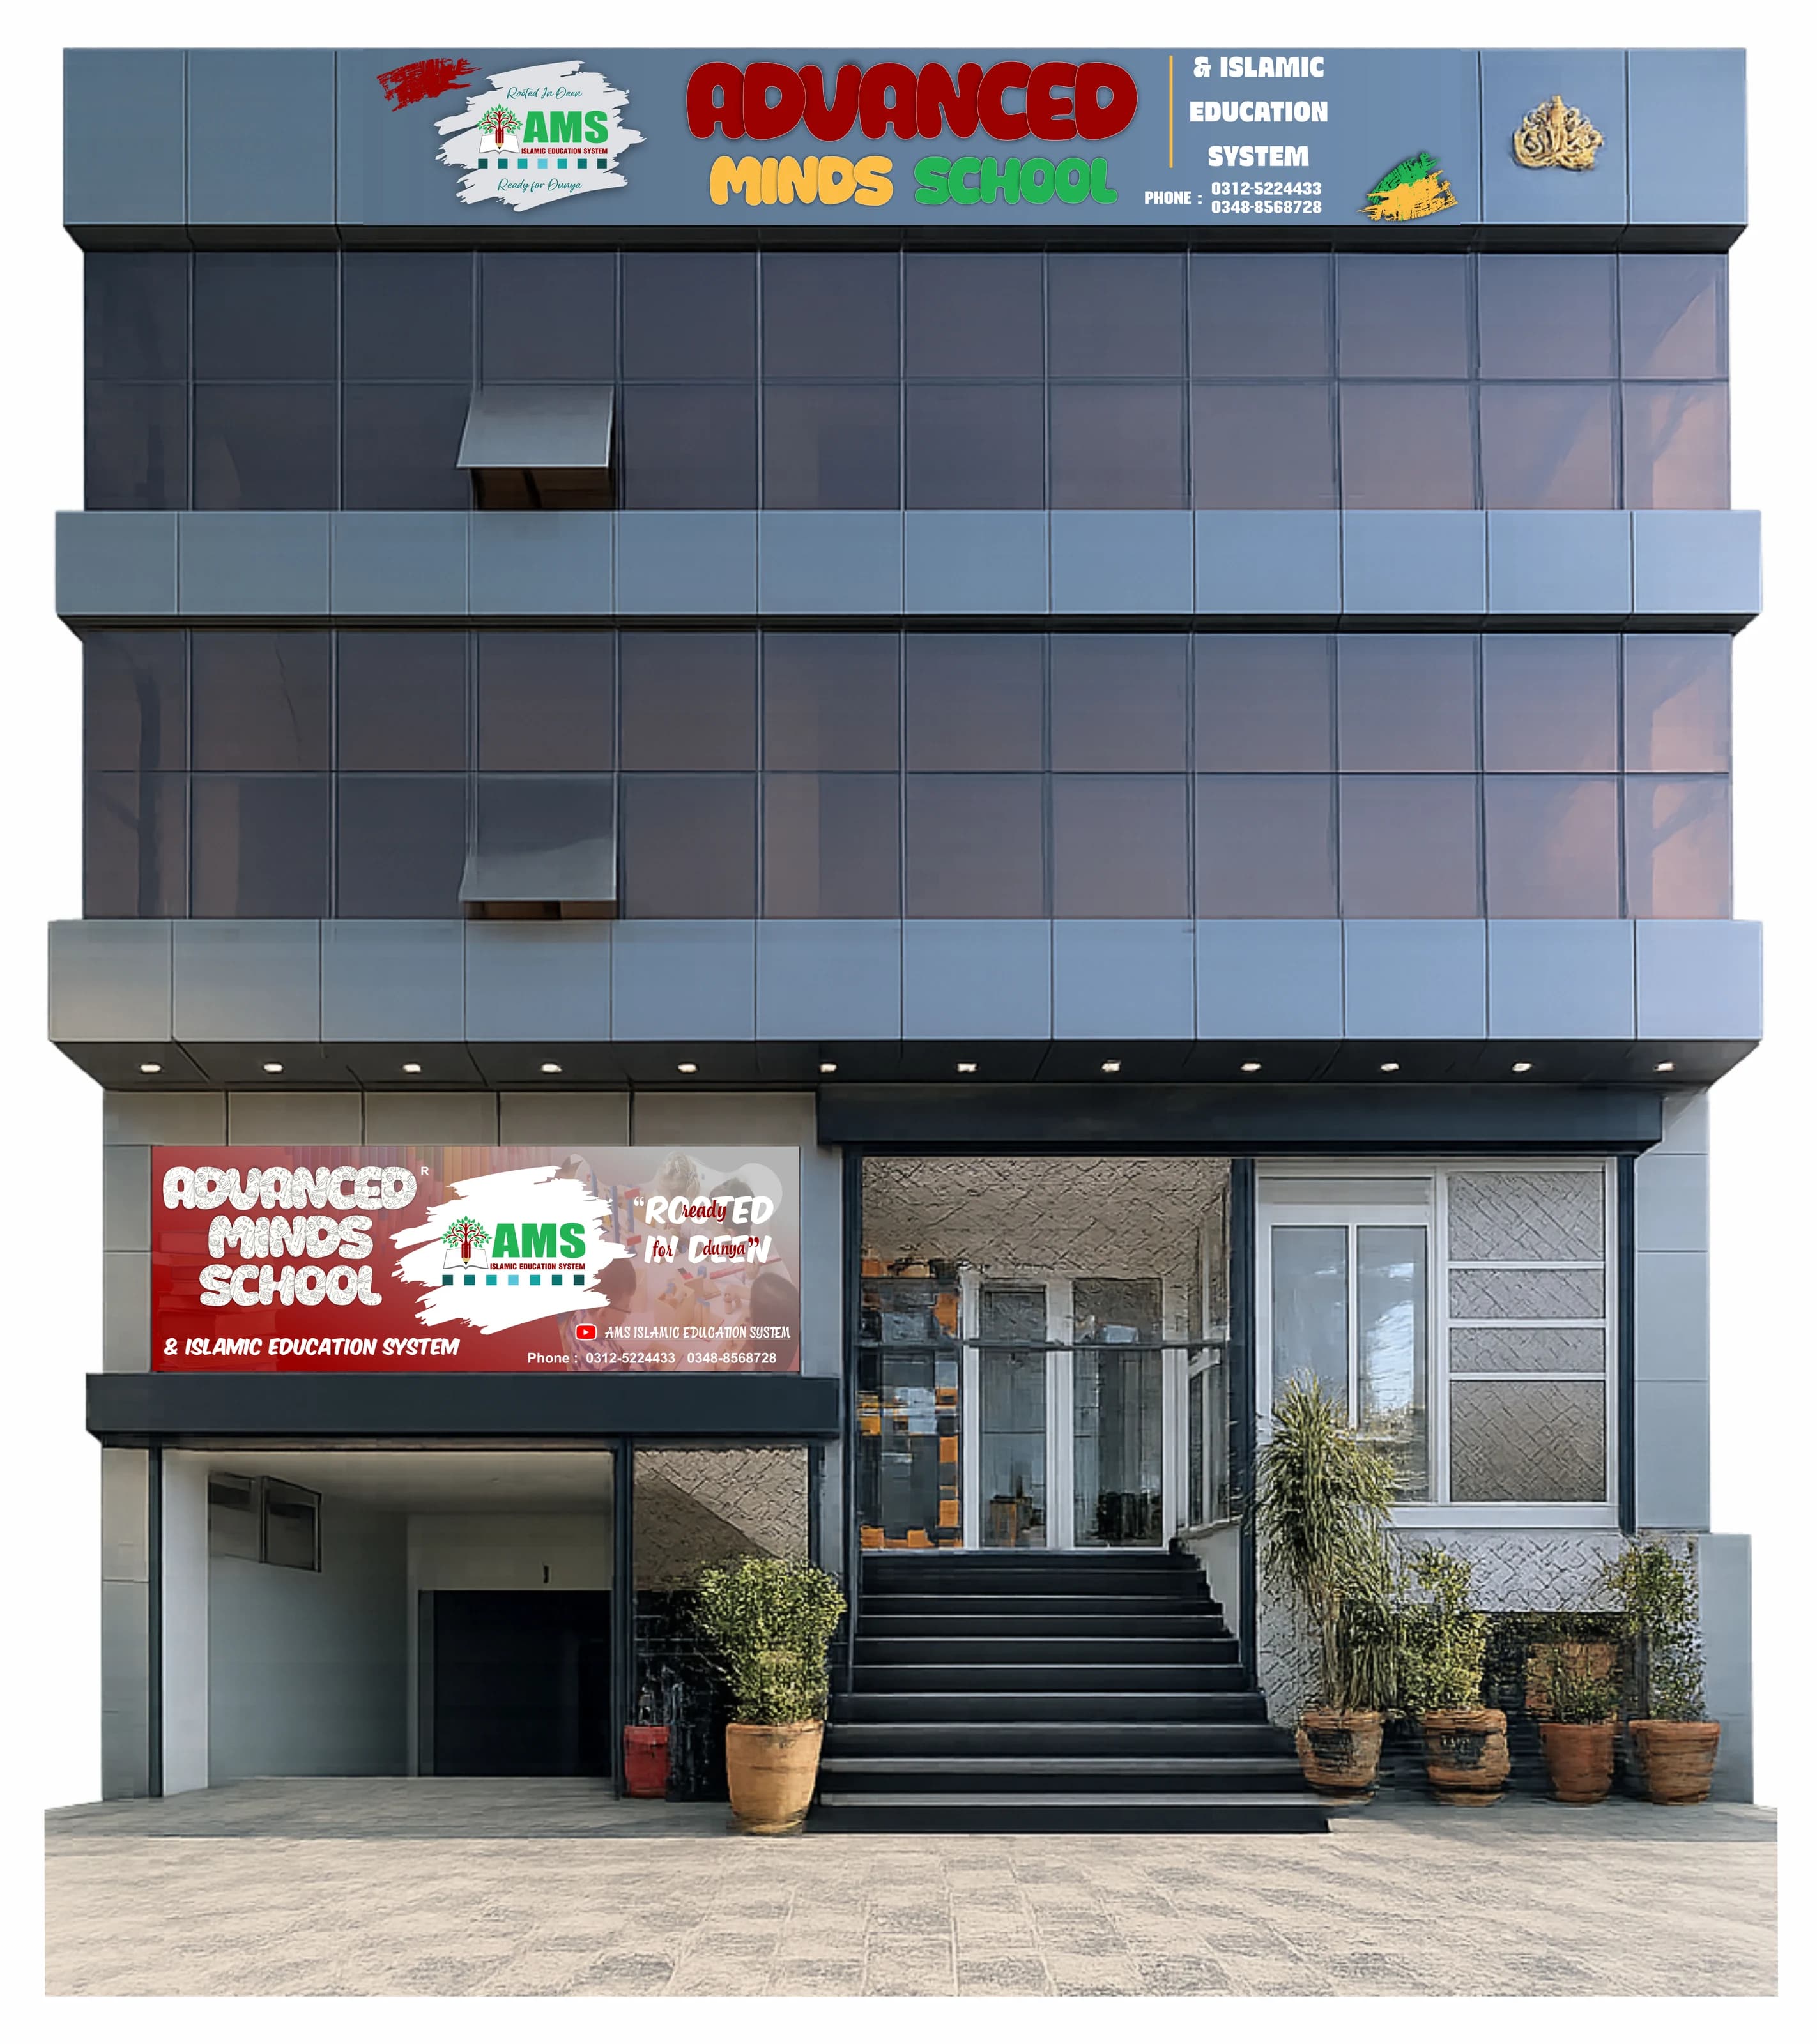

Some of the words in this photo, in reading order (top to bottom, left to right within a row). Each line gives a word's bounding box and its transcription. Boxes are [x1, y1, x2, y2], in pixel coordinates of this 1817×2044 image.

[1193, 56, 1211, 77] &
[1220, 56, 1324, 77] ISLAMIC
[506, 86, 540, 99] Rooted
[541, 86, 554, 99] In
[555, 86, 582, 99] Deen
[686, 61, 1138, 142] ADVANCED
[1190, 101, 1328, 122] EDUCATION
[523, 111, 608, 143] AMS
[1208, 146, 1309, 167] SYSTEM
[497, 178, 529, 193] Ready
[530, 181, 545, 192] for
[548, 178, 582, 193] Dunya
[710, 155, 893, 206] MINDS
[914, 156, 1117, 204] SCHOOL
[1211, 182, 1322, 195] 0312-5224433
[1145, 191, 1192, 204] PHONE
[1211, 201, 1322, 214] 0348-8568728
[162, 1166, 417, 1210] ADVANCED
[682, 1200, 726, 1222] ready
[208, 1215, 373, 1259] MINDS
[492, 1223, 586, 1258] AMS
[653, 1240, 673, 1257] for
[199, 1264, 383, 1306] SCHOOL
[604, 1326, 631, 1339] AMS
[634, 1326, 680, 1339] ISLAMIC
[683, 1326, 746, 1339] EDUCATION
[749, 1326, 791, 1339] SYSTEM
[164, 1338, 178, 1355] &
[185, 1338, 262, 1355] ISLAMIC
[268, 1338, 377, 1355] EDUCATION
[381, 1338, 460, 1355] SYSTEM
[528, 1352, 569, 1363] Phone
[586, 1352, 675, 1363] 0312-5224433
[687, 1352, 777, 1363] 0348-8568728
